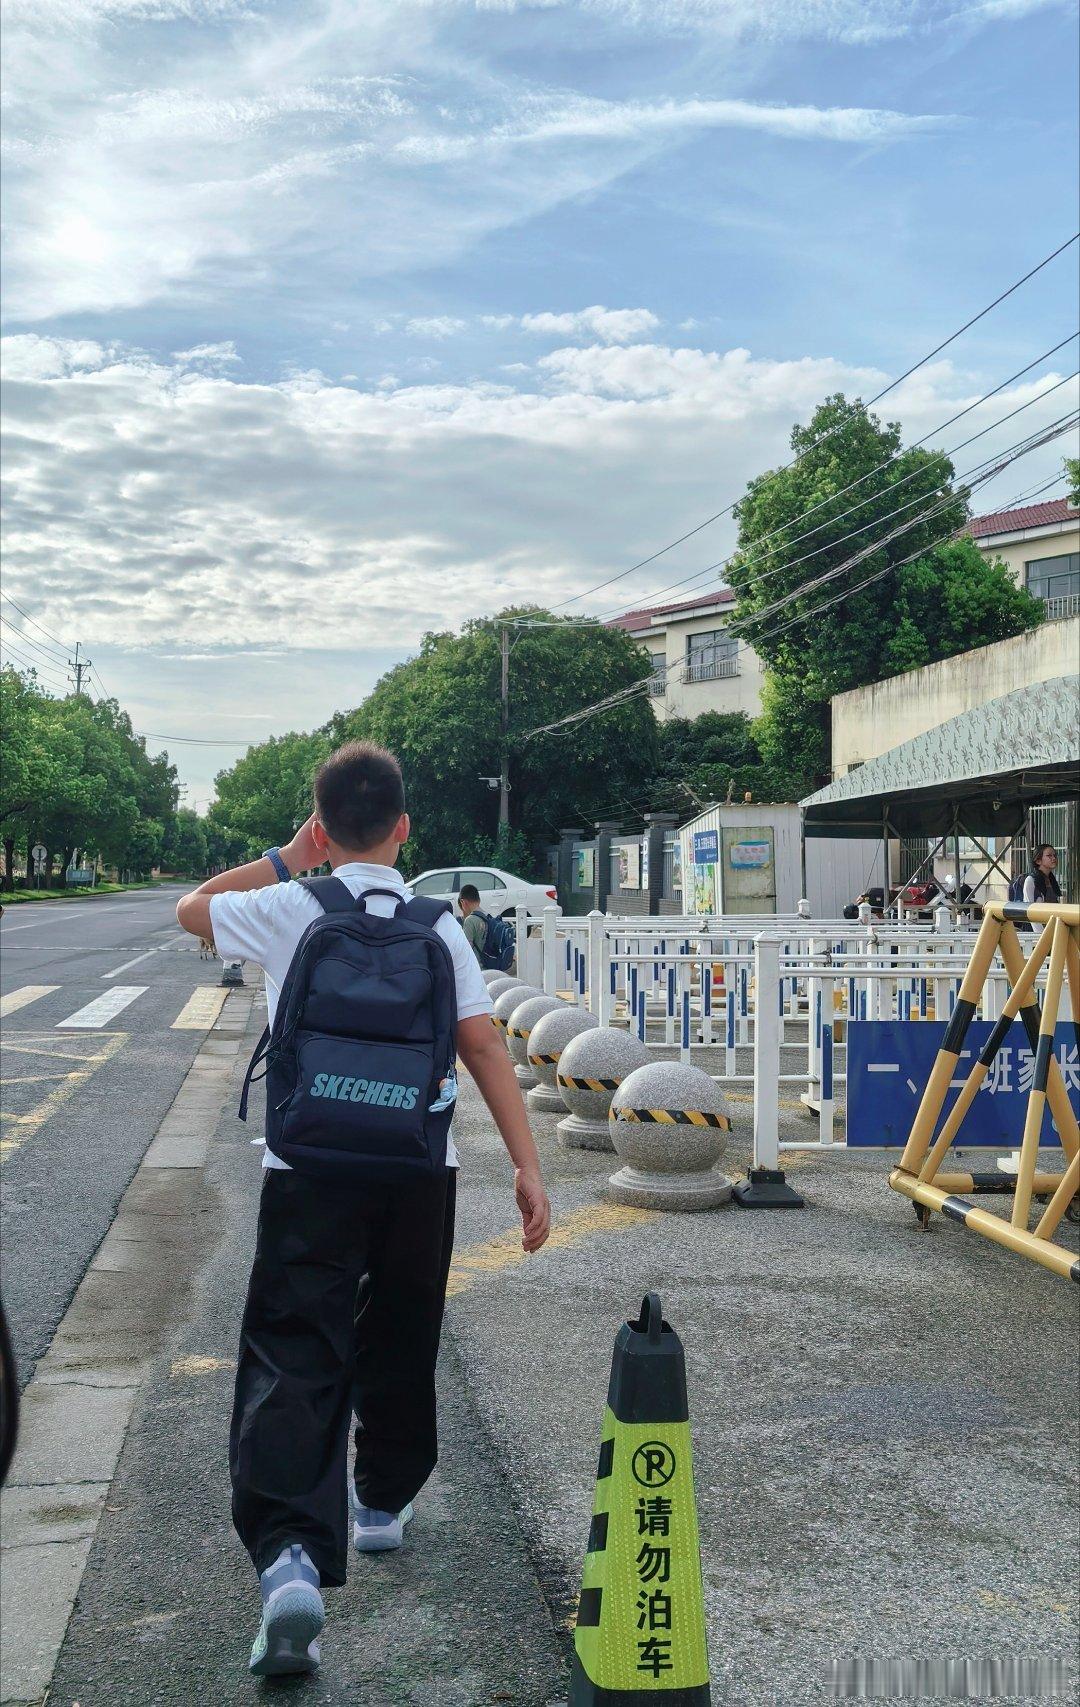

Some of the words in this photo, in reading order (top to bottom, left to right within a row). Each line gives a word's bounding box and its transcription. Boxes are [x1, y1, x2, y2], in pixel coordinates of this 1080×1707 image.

[310, 1073, 420, 1110] SKECHERS
[634, 1496, 674, 1679] 请勿泊车
